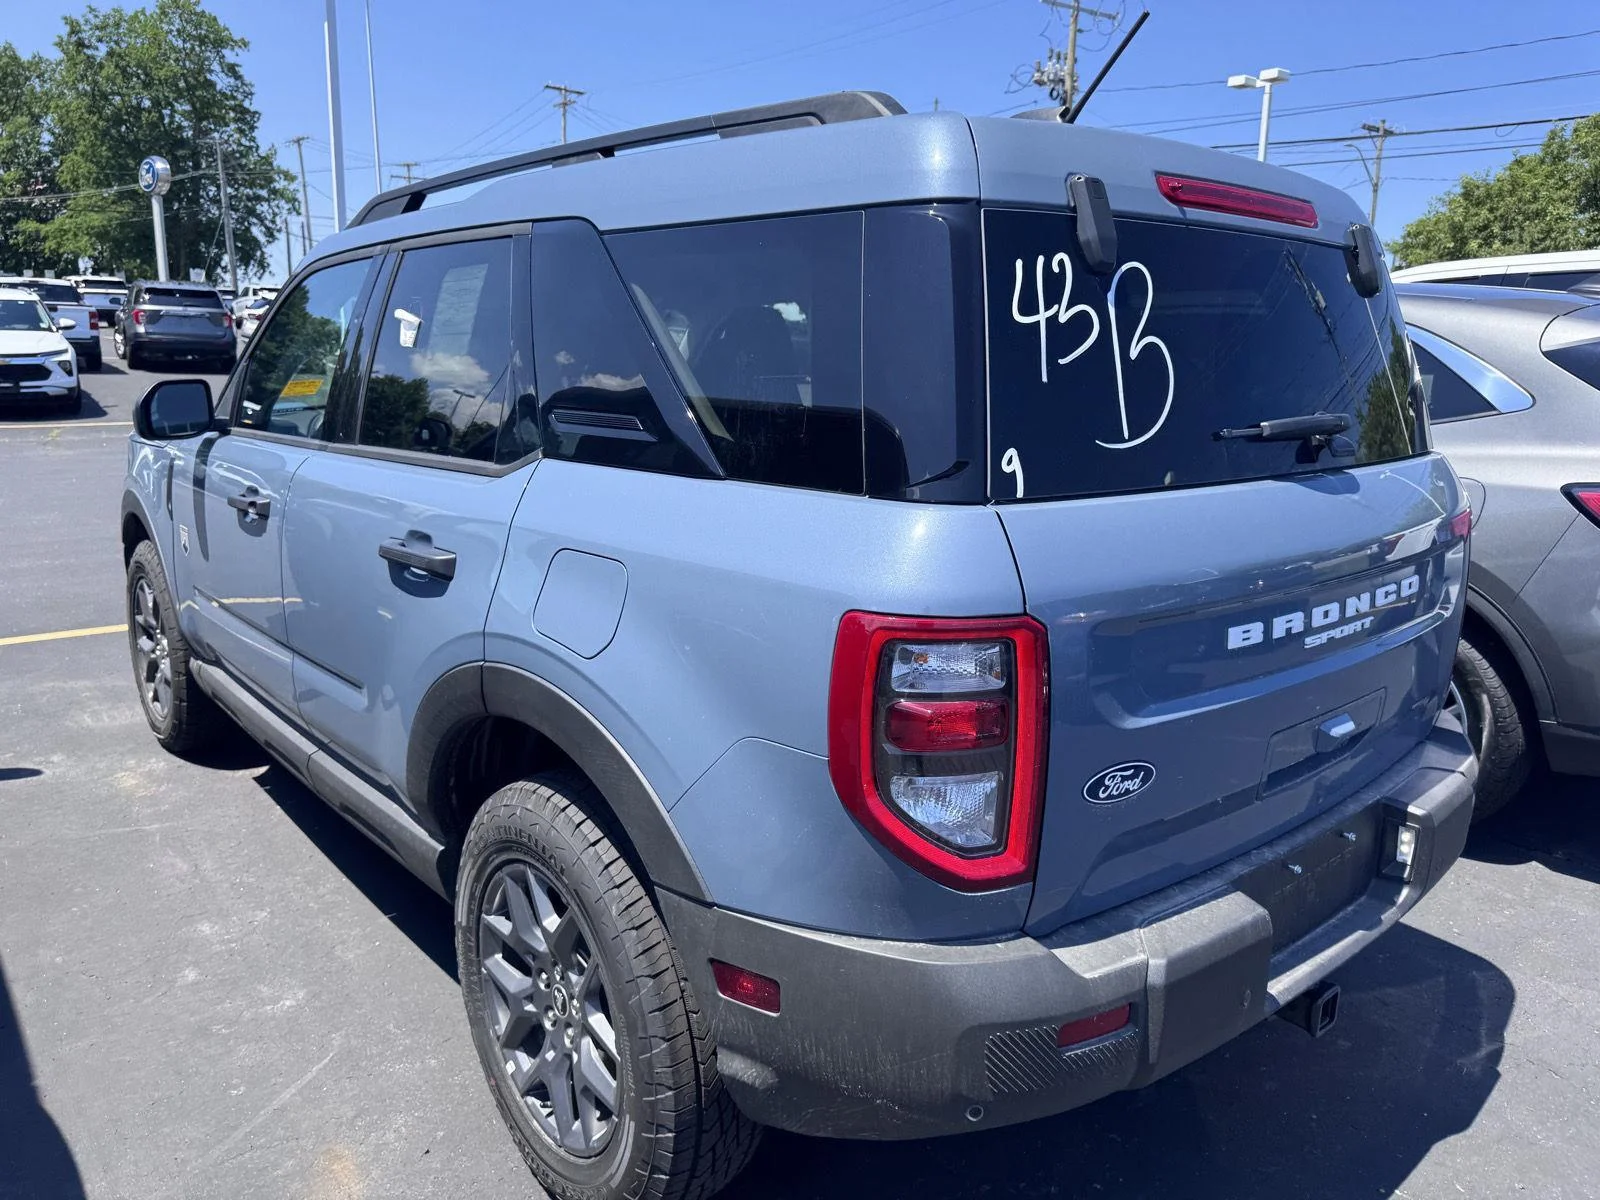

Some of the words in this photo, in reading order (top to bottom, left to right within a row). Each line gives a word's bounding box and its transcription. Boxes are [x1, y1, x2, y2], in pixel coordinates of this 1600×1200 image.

[1001, 447, 1024, 498] 9
[1227, 574, 1420, 650] BRONCO
[1304, 616, 1375, 648] SPORT
[1098, 769, 1144, 799] Ford
